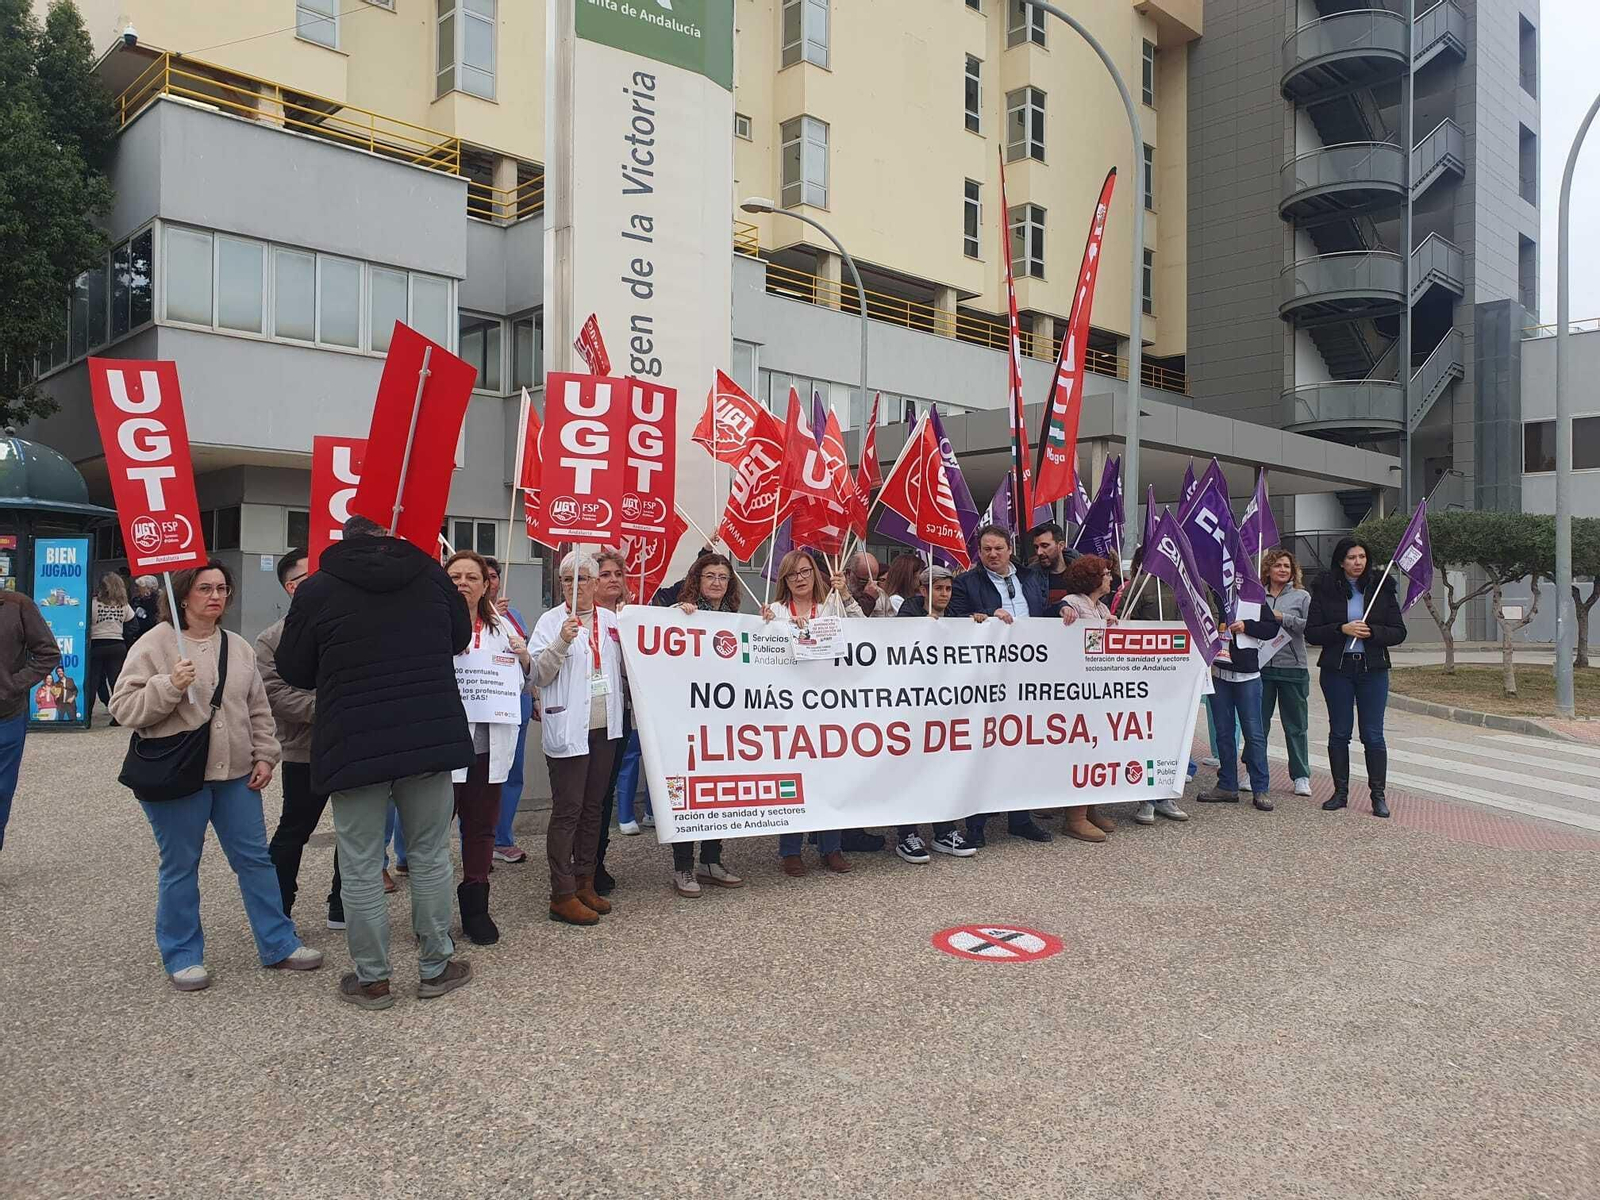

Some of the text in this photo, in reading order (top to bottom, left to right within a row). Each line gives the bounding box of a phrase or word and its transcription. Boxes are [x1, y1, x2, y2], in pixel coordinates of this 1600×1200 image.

[587, 0, 701, 38] unta de Andalucía
[621, 70, 662, 378] gen de la Victoria
[715, 398, 755, 434] UGT
[106, 369, 176, 512] UGT
[560, 380, 611, 494] UGT
[628, 386, 665, 493] UGT
[731, 442, 782, 505] UGT
[553, 501, 576, 513] UGT
[582, 503, 600, 513] FSP
[622, 497, 639, 509] UGT
[643, 501, 657, 510] FSP
[135, 522, 157, 539] UGT
[161, 521, 179, 532] FSP
[46, 547, 76, 564] BIEN
[40, 564, 82, 577] JUGADO
[637, 625, 706, 657] UGT
[752, 633, 789, 644] Servicios
[1108, 633, 1171, 650] CCOO
[752, 643, 786, 654] Públicos
[834, 641, 1048, 667] NO MÁS RETRASOS
[754, 655, 798, 666] Andalucía
[1085, 655, 1114, 663] federación
[1126, 655, 1156, 663] sanidad
[1156, 656, 1162, 664] y
[1085, 664, 1130, 672] sociosanitarios
[475, 688, 517, 696] profesionales
[689, 681, 1149, 710] NO MÁS CONTRATACIONES IRREGULARES
[687, 710, 1153, 771] ¡LISTADOS DE BOLSA, YA!
[1072, 762, 1121, 788] UGT
[694, 780, 777, 803] CCOO
[674, 806, 806, 821] ración de sanidad y sectores
[730, 820, 743, 830] de
[744, 818, 790, 829] Andalucía
